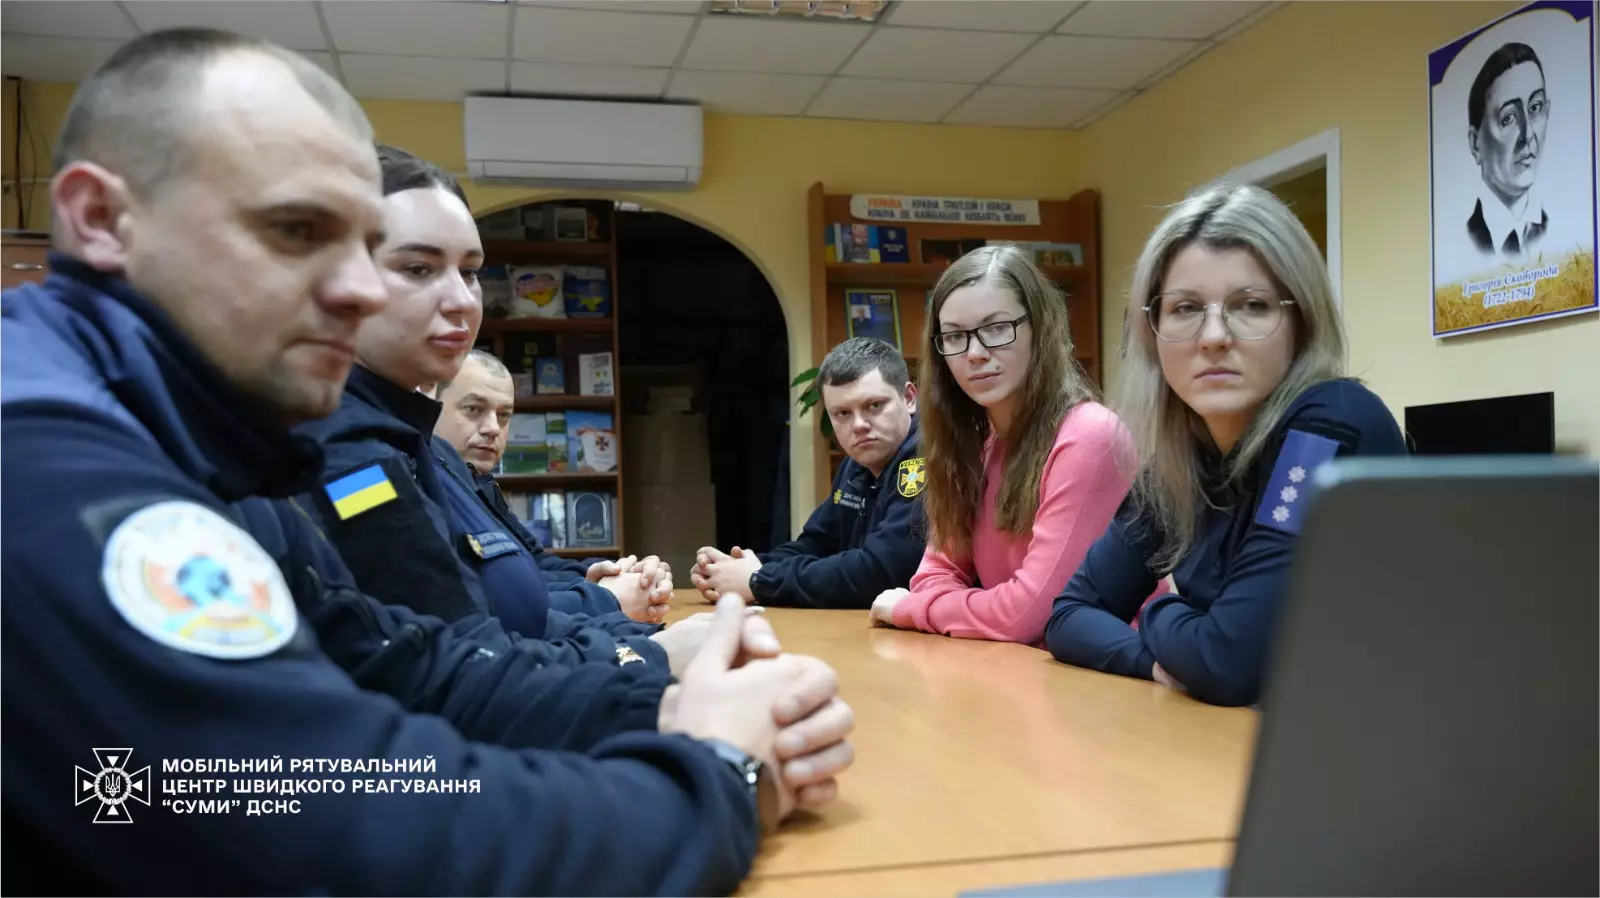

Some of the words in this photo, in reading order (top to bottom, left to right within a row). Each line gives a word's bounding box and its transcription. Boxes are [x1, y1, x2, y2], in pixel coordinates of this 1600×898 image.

[867, 197, 901, 208] УКРАЇНА
[911, 199, 939, 209] КРАЇНА
[1504, 264, 1558, 285] Сковорода
[1484, 285, 1534, 306] (1722-1794)
